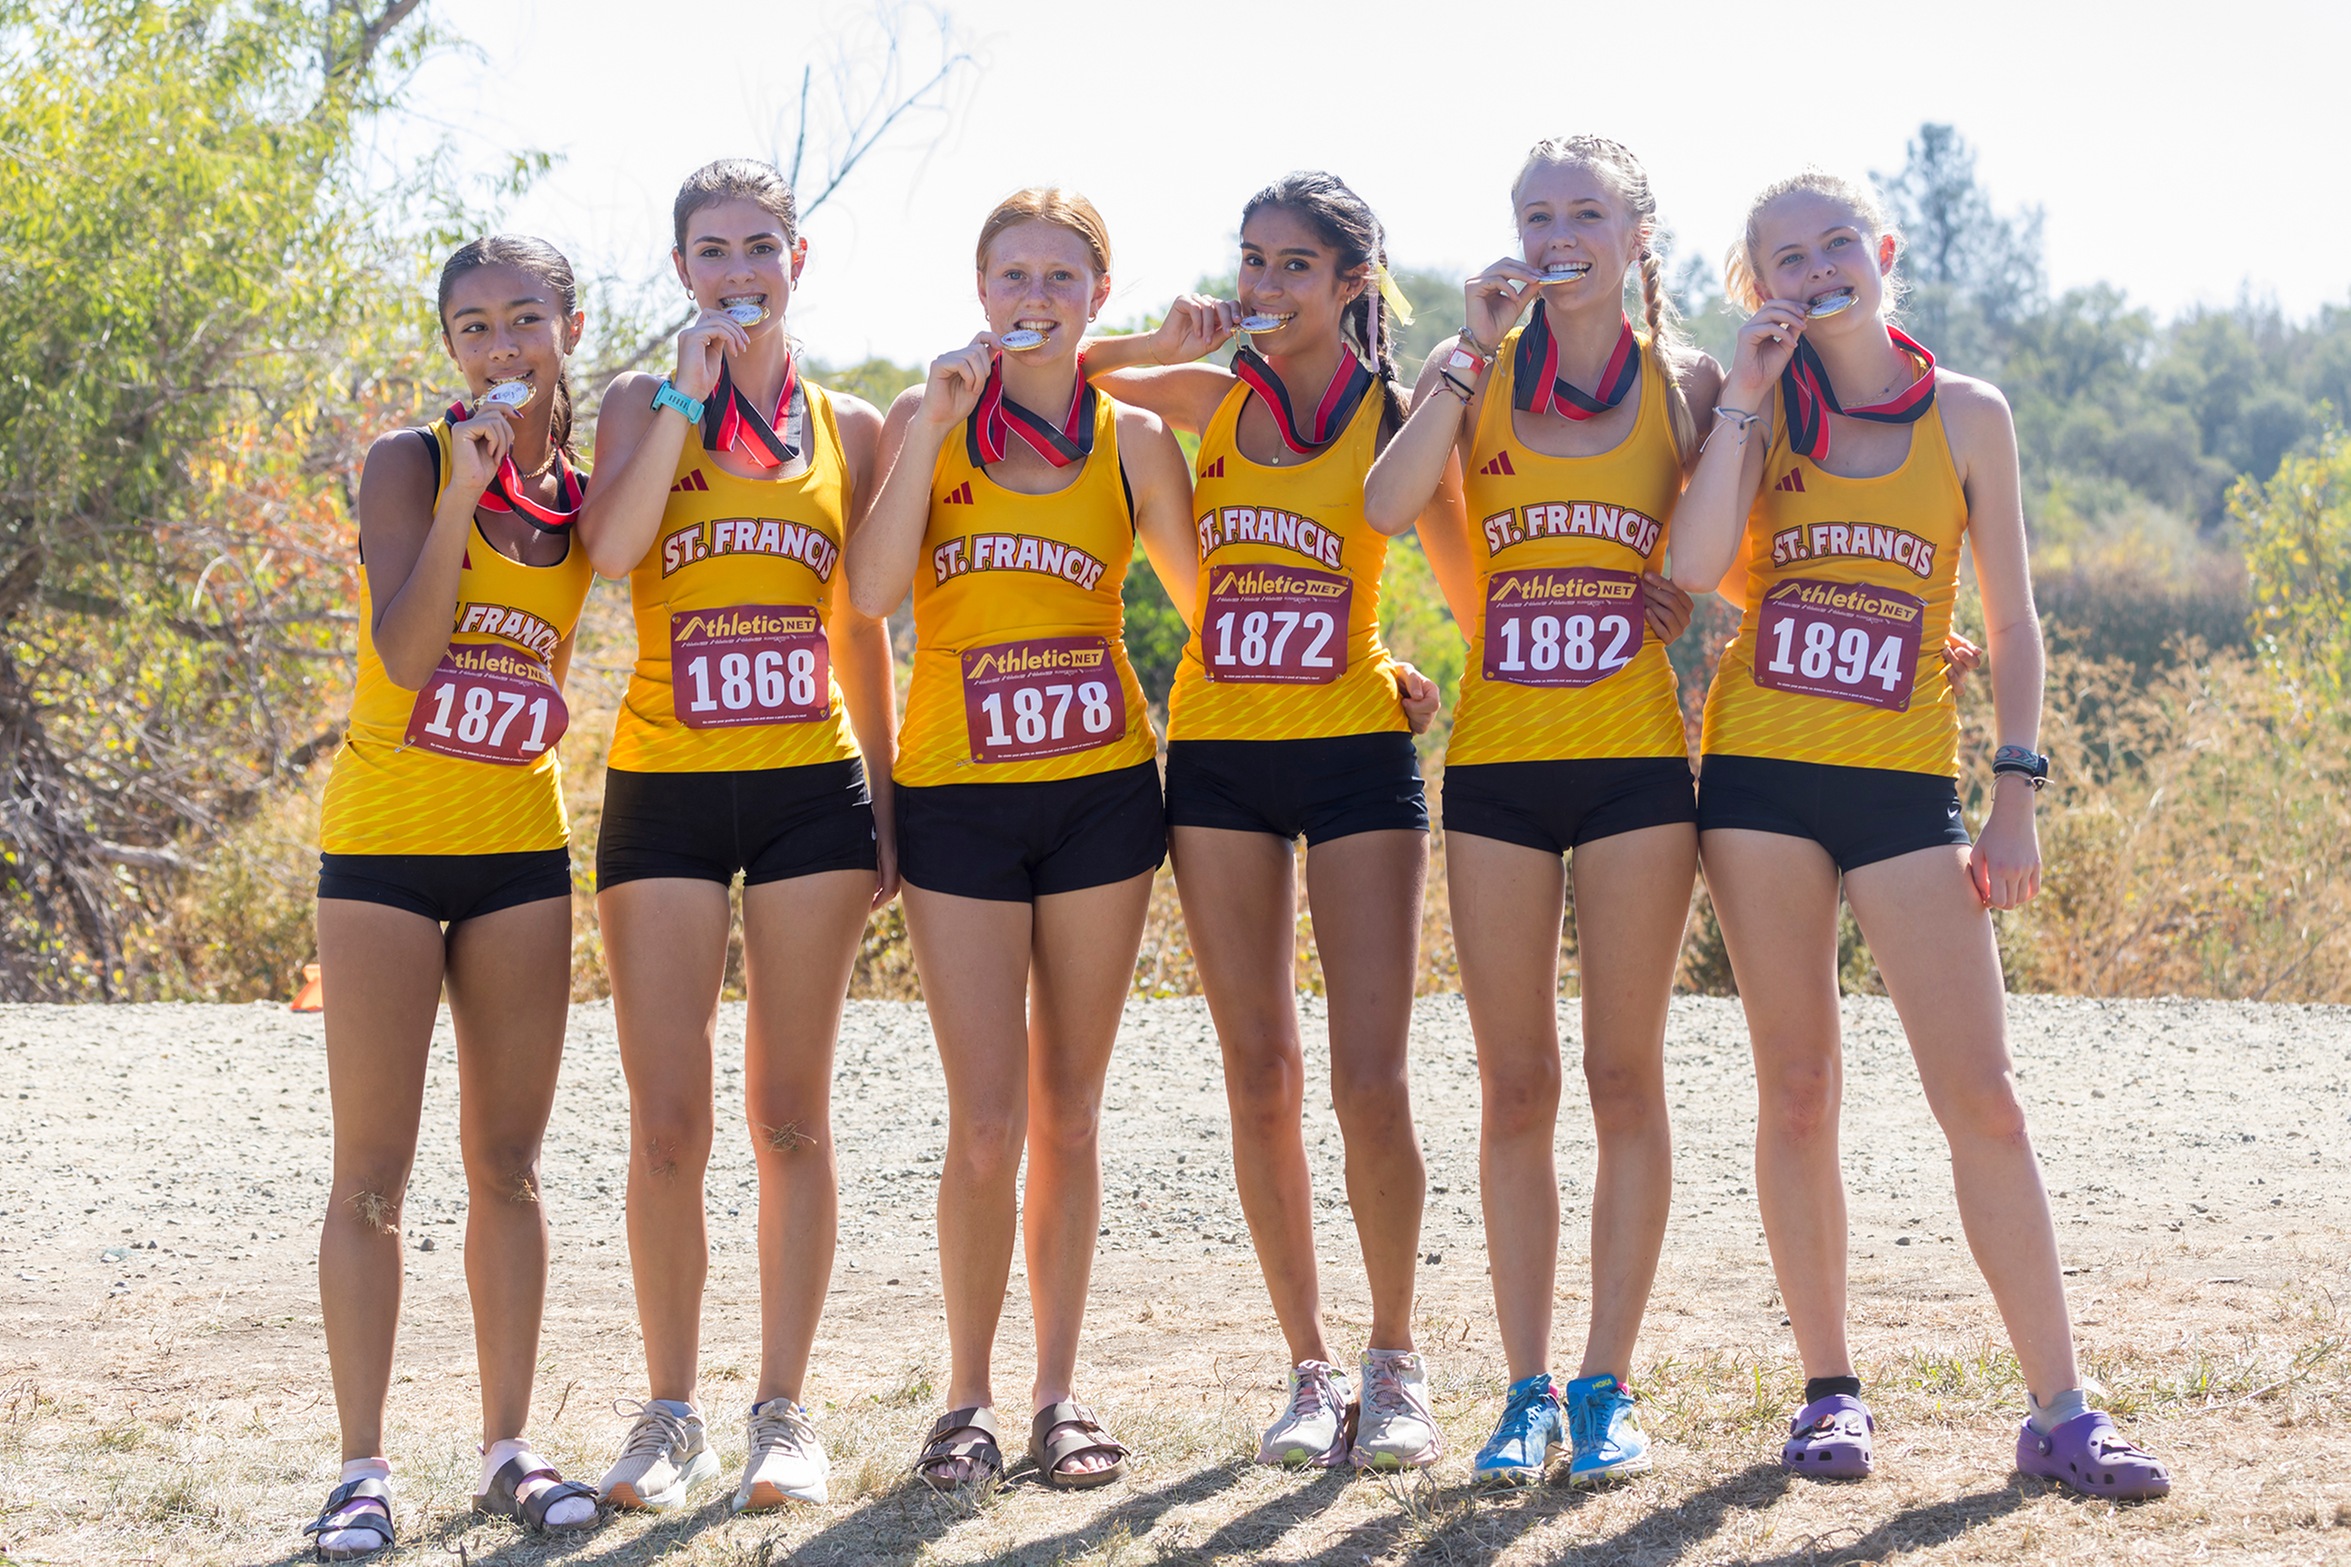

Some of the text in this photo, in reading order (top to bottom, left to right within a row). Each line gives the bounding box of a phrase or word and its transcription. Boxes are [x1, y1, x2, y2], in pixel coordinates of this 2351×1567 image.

[662, 517, 841, 584] ST. FRANCIS
[1198, 505, 1345, 571] ST. FRANCIS
[1482, 500, 1664, 560] ST. FRANCIS
[1771, 522, 1937, 580] ST. FRANCIS
[933, 532, 1108, 592] ST. FRANCIS
[446, 648, 528, 678] thletic
[1213, 611, 1336, 668] 1872
[1499, 614, 1632, 672] 1882
[1767, 617, 1904, 692] 1894
[687, 649, 816, 713] 1868
[424, 682, 549, 752] 1871
[981, 681, 1113, 747] 1878
